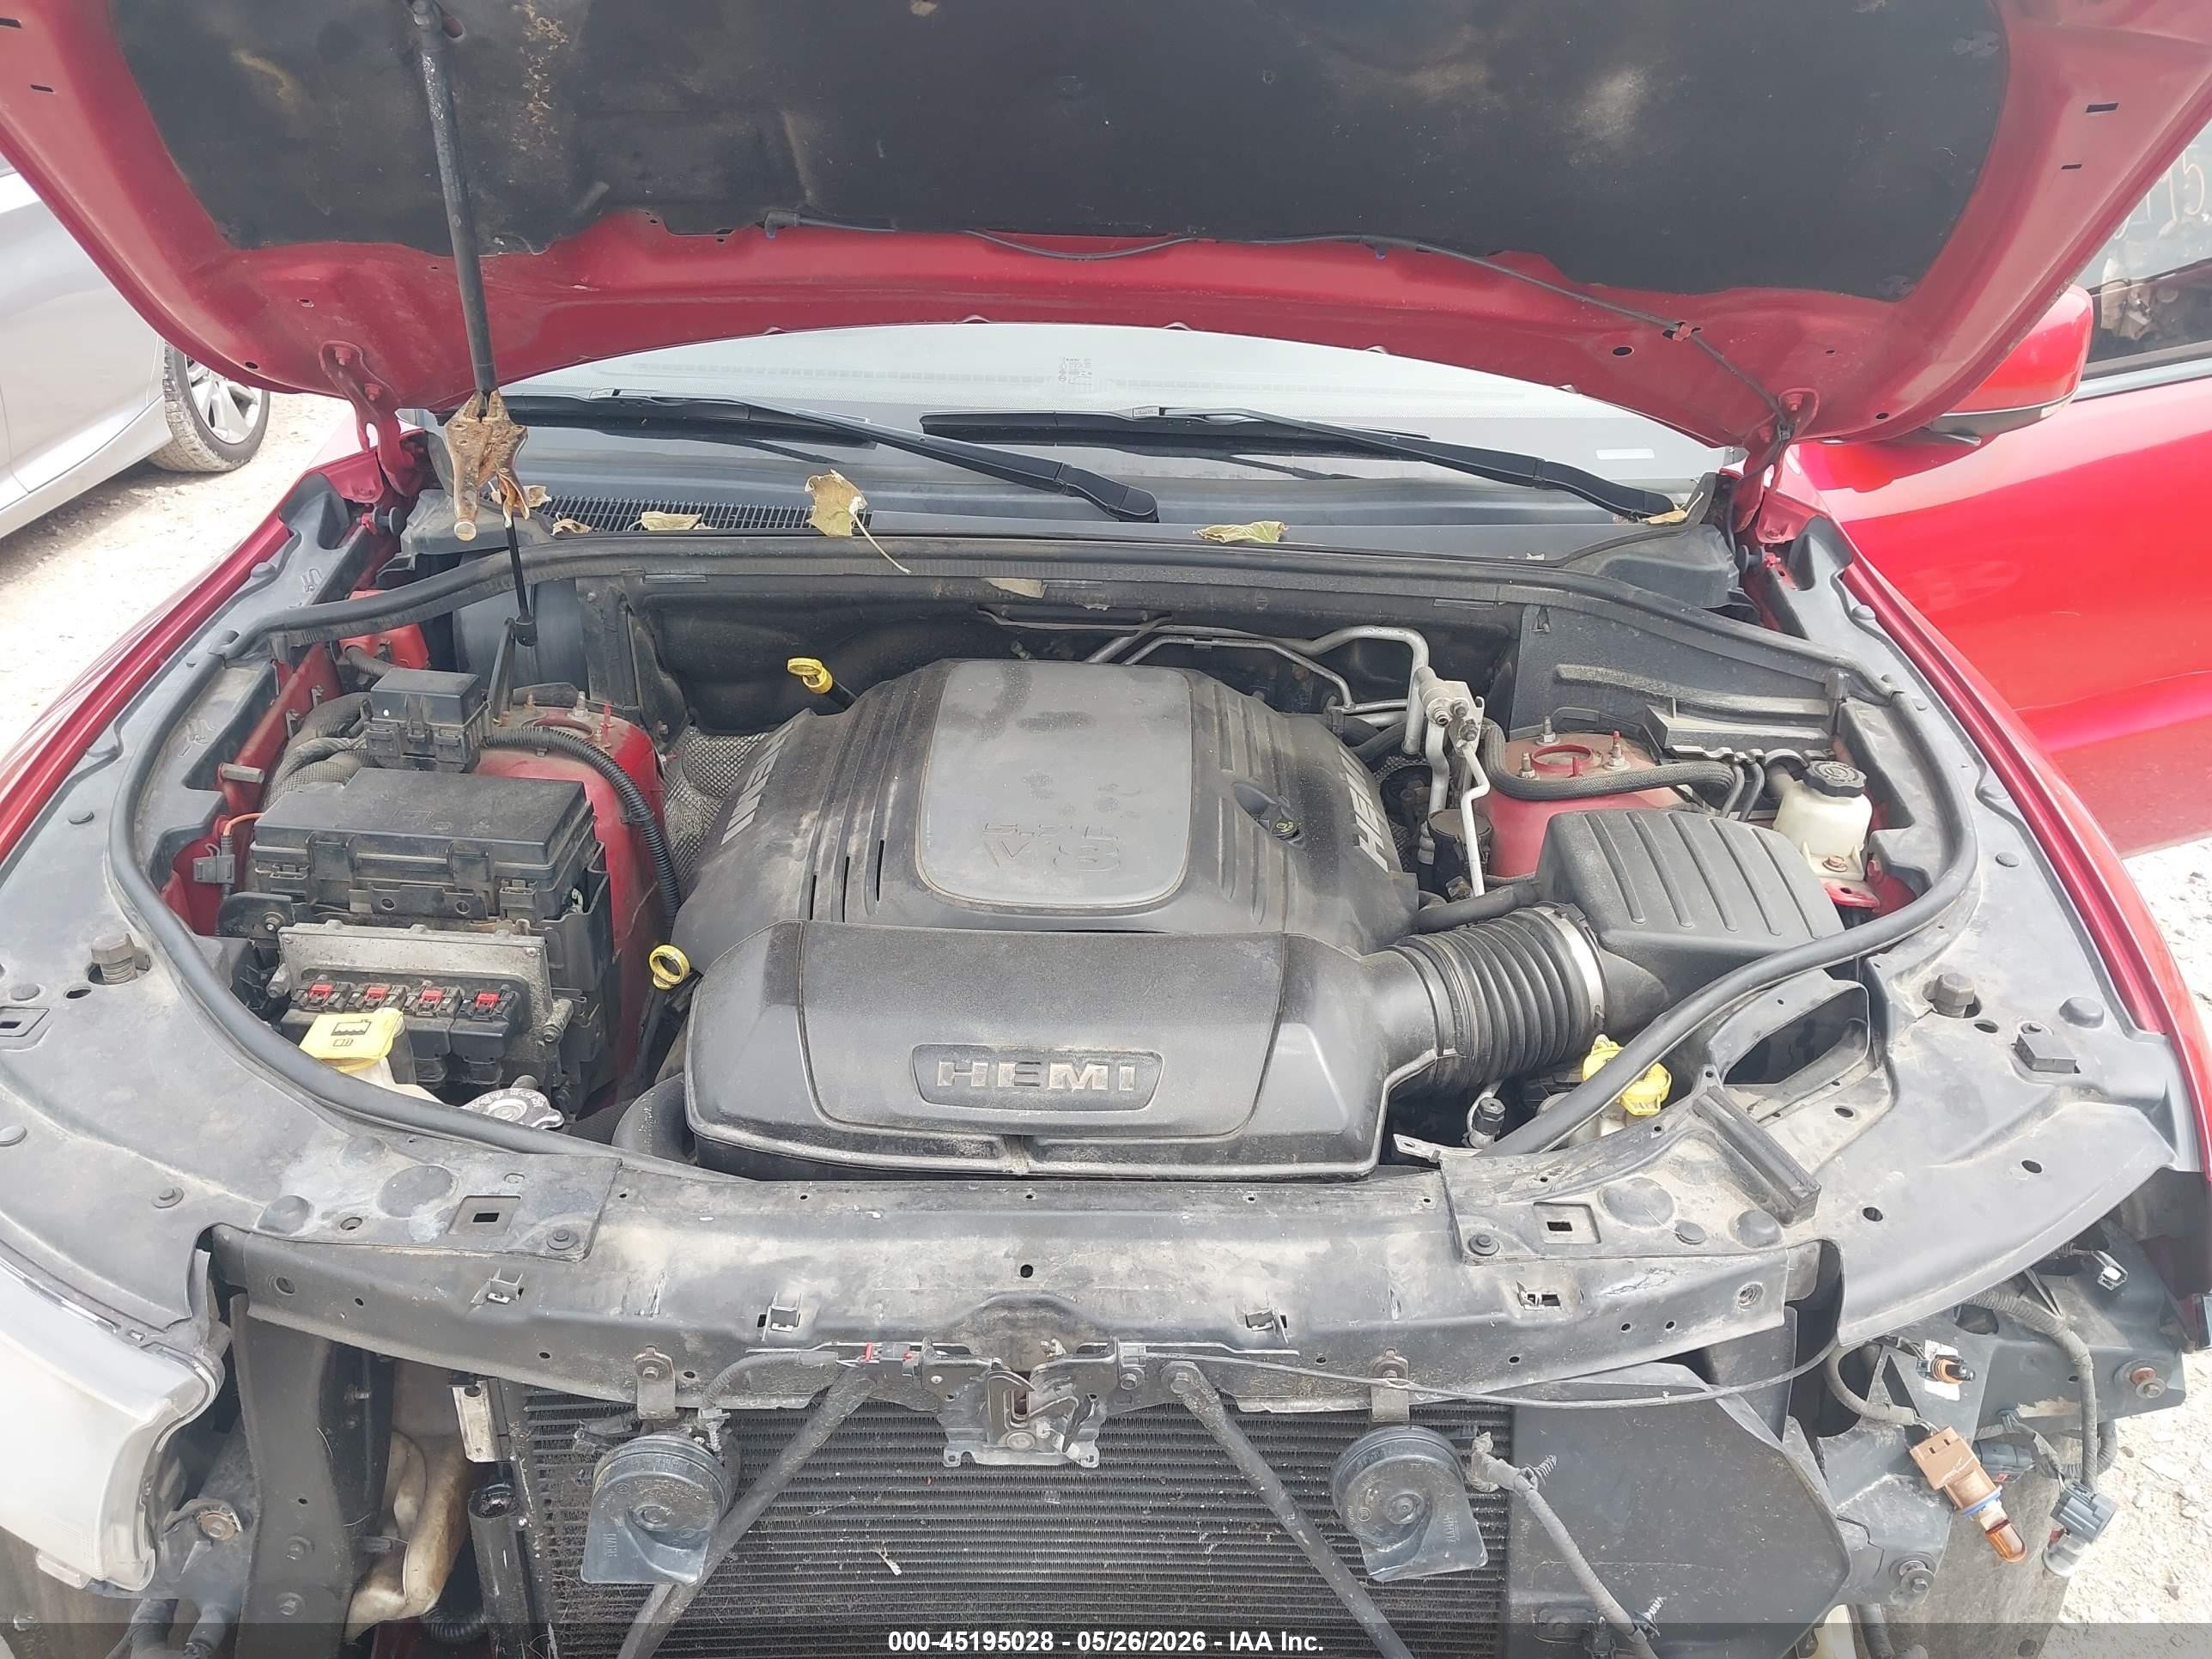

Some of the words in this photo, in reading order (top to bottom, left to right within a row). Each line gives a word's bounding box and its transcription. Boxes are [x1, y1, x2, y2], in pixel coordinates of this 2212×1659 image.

[721, 720, 795, 845] HEMI
[1338, 744, 1389, 873] HEMI
[936, 1058, 1137, 1091] HEMI
